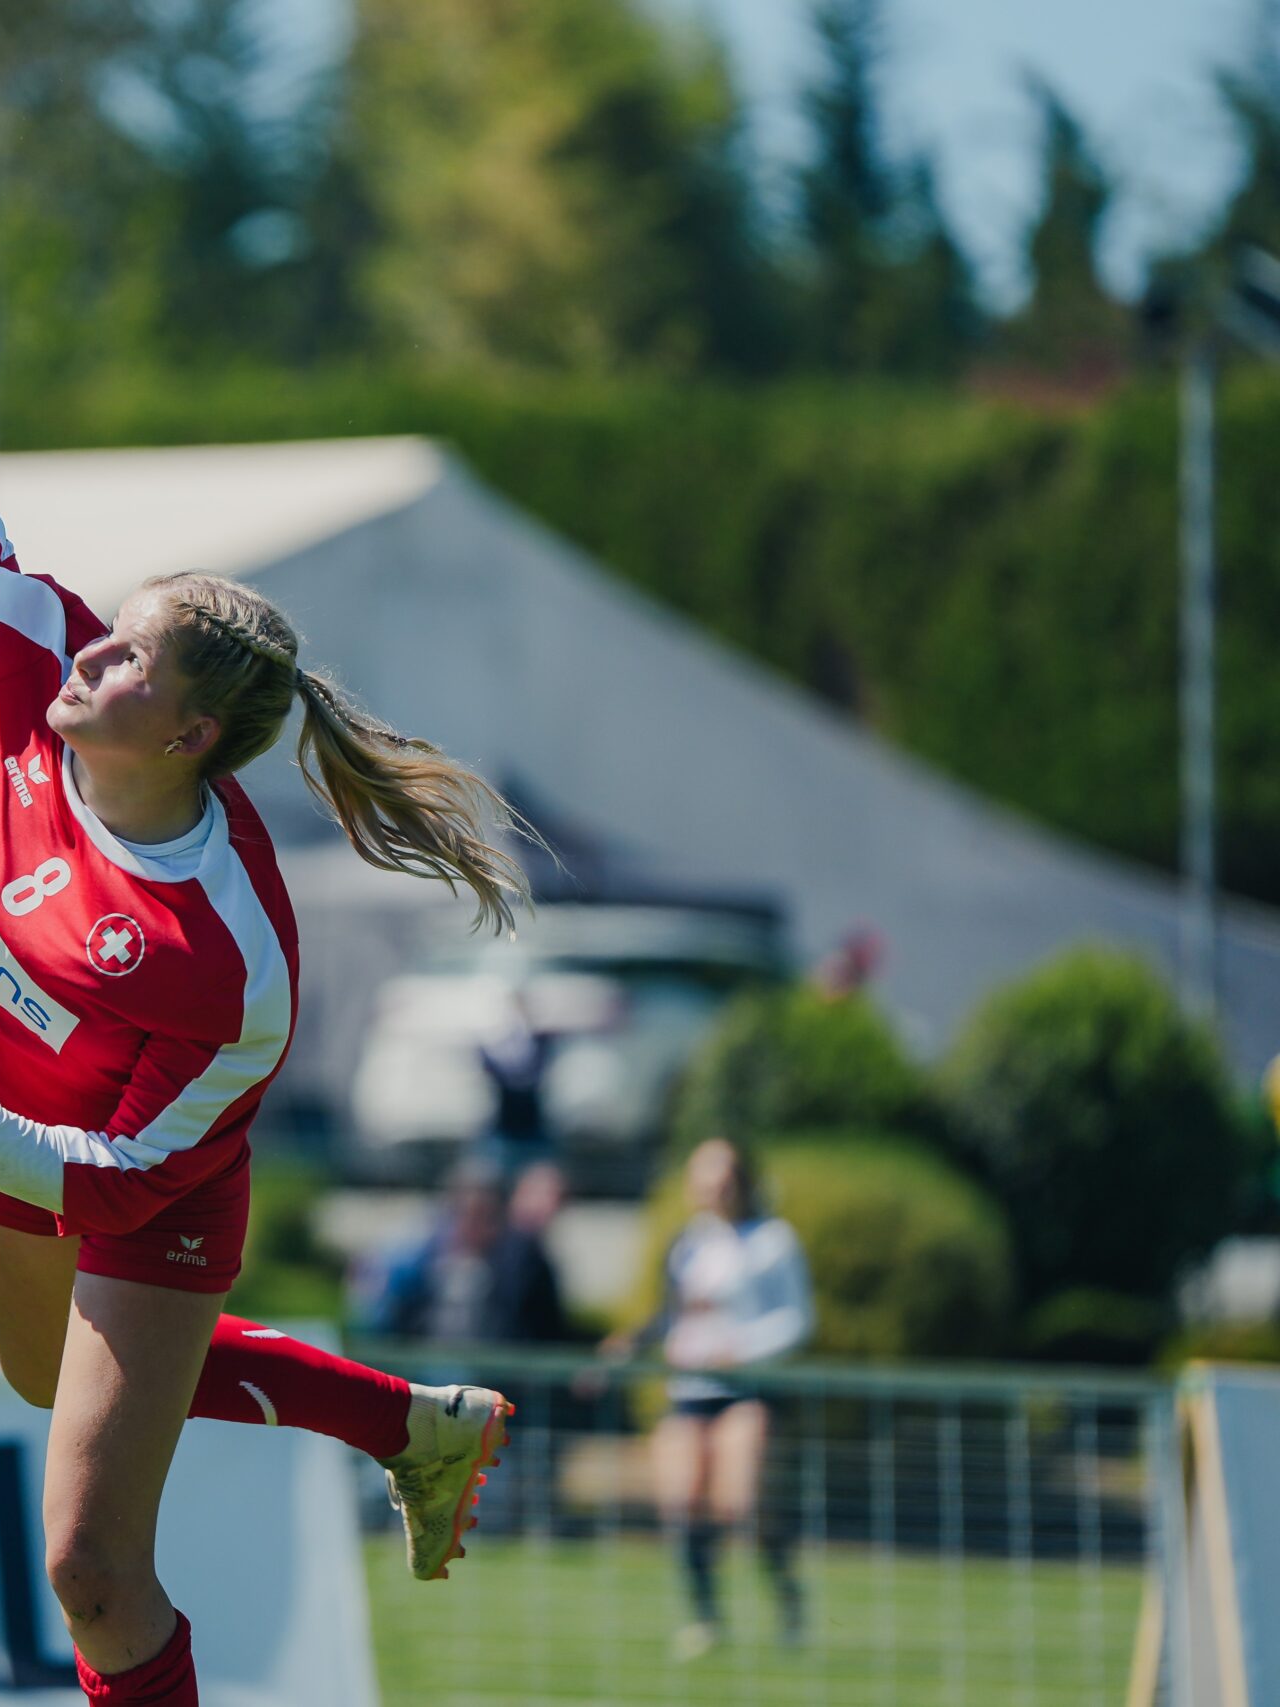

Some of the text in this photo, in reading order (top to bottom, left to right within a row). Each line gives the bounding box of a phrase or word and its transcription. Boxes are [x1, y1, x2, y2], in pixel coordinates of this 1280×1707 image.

[3, 755, 33, 809] erima
[1, 856, 71, 916] 8
[166, 1249, 208, 1267] erima
